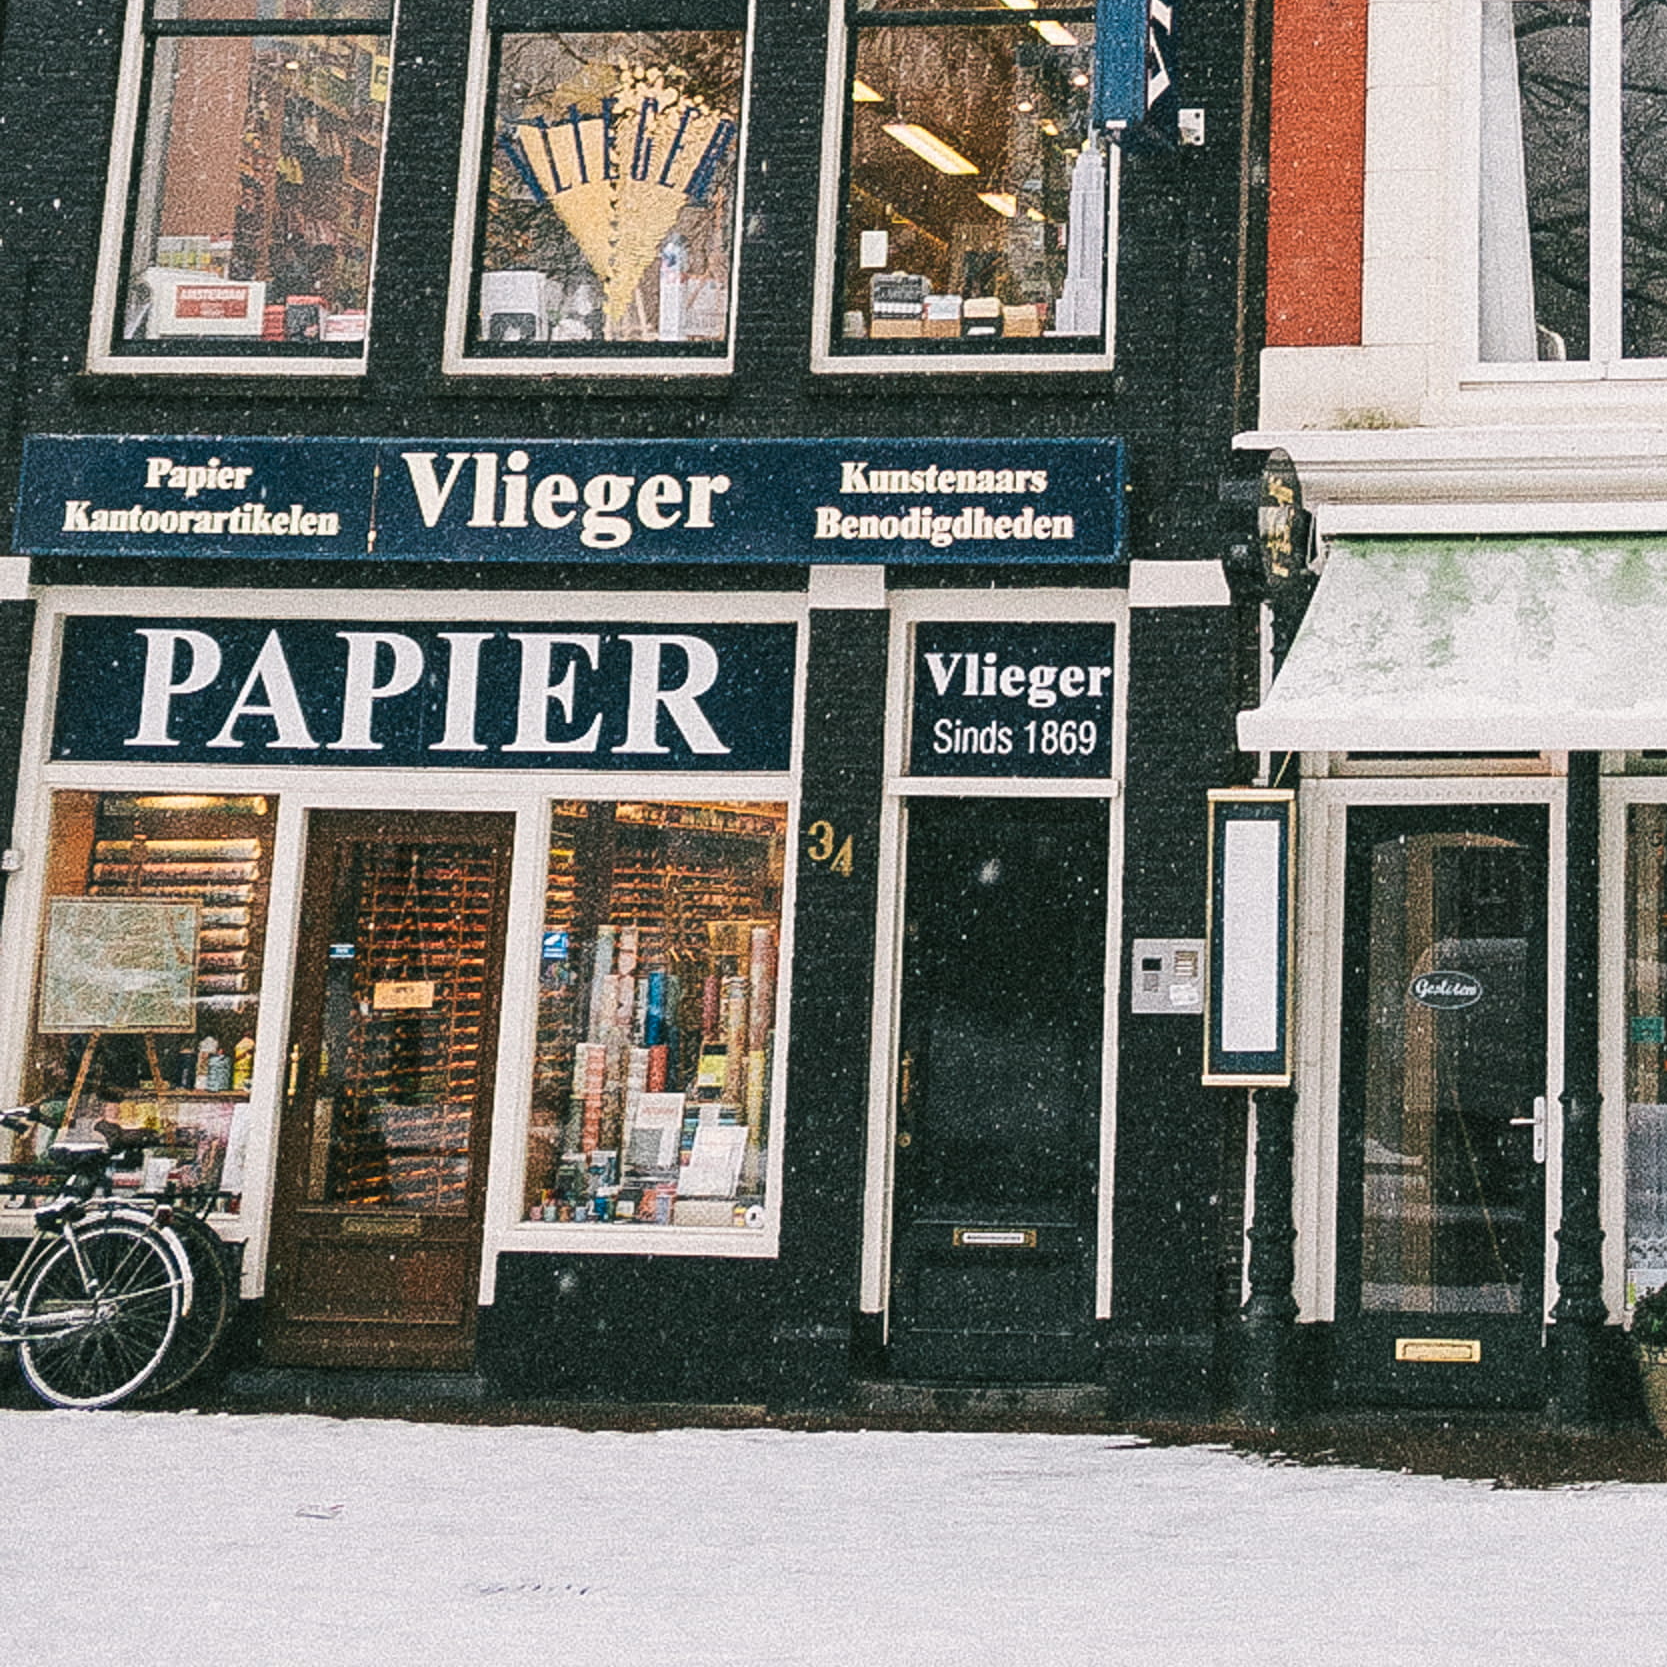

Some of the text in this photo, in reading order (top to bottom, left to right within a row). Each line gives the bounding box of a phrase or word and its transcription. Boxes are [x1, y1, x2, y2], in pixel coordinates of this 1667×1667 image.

[144, 457, 253, 497] Papier
[840, 462, 1048, 495] Kunstenaars
[62, 500, 340, 536] Kantoorartikelen
[401, 450, 730, 549] Vlieger
[814, 506, 1075, 547] Benodigdheden
[123, 627, 732, 754] PAPIER
[923, 651, 1113, 708] Vlieger
[933, 718, 1098, 755] Sinds 1869
[807, 820, 855, 878] 34
